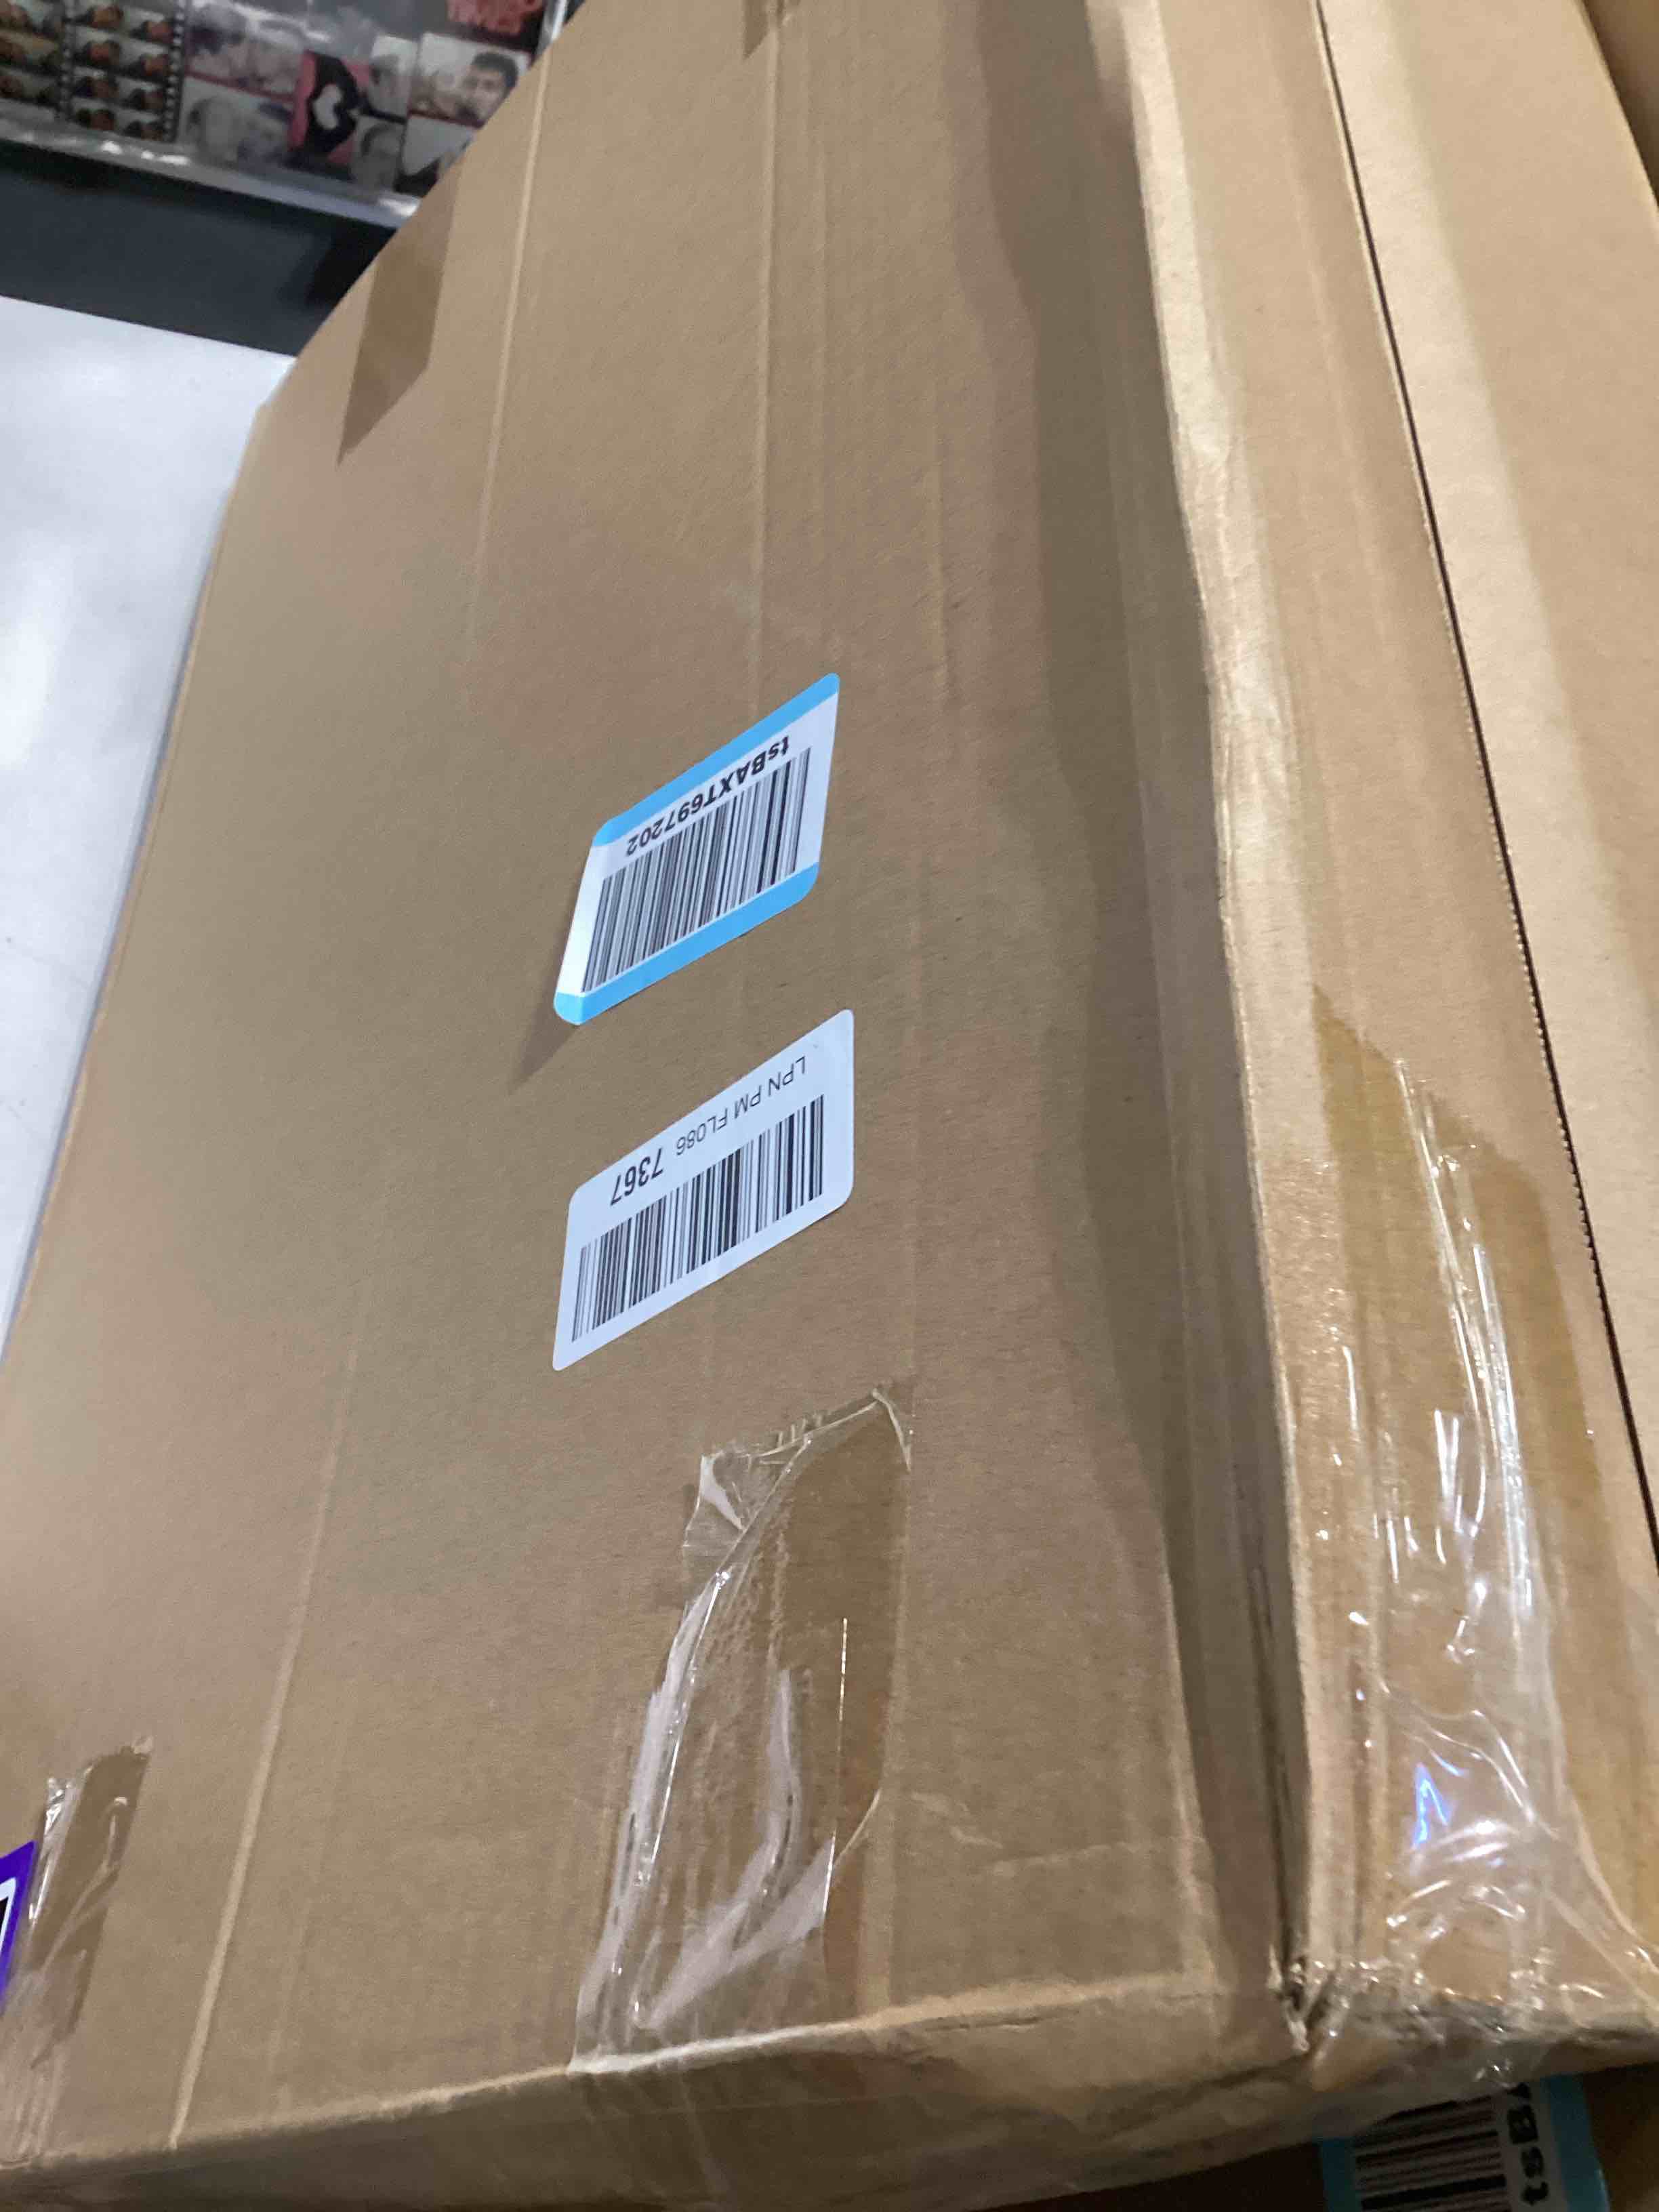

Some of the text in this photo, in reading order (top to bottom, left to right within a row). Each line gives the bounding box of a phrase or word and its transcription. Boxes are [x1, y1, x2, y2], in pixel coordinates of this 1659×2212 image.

[626, 737, 790, 856] tsBAXT697202
[611, 1056, 806, 1205] LPN PM FL086 7367
